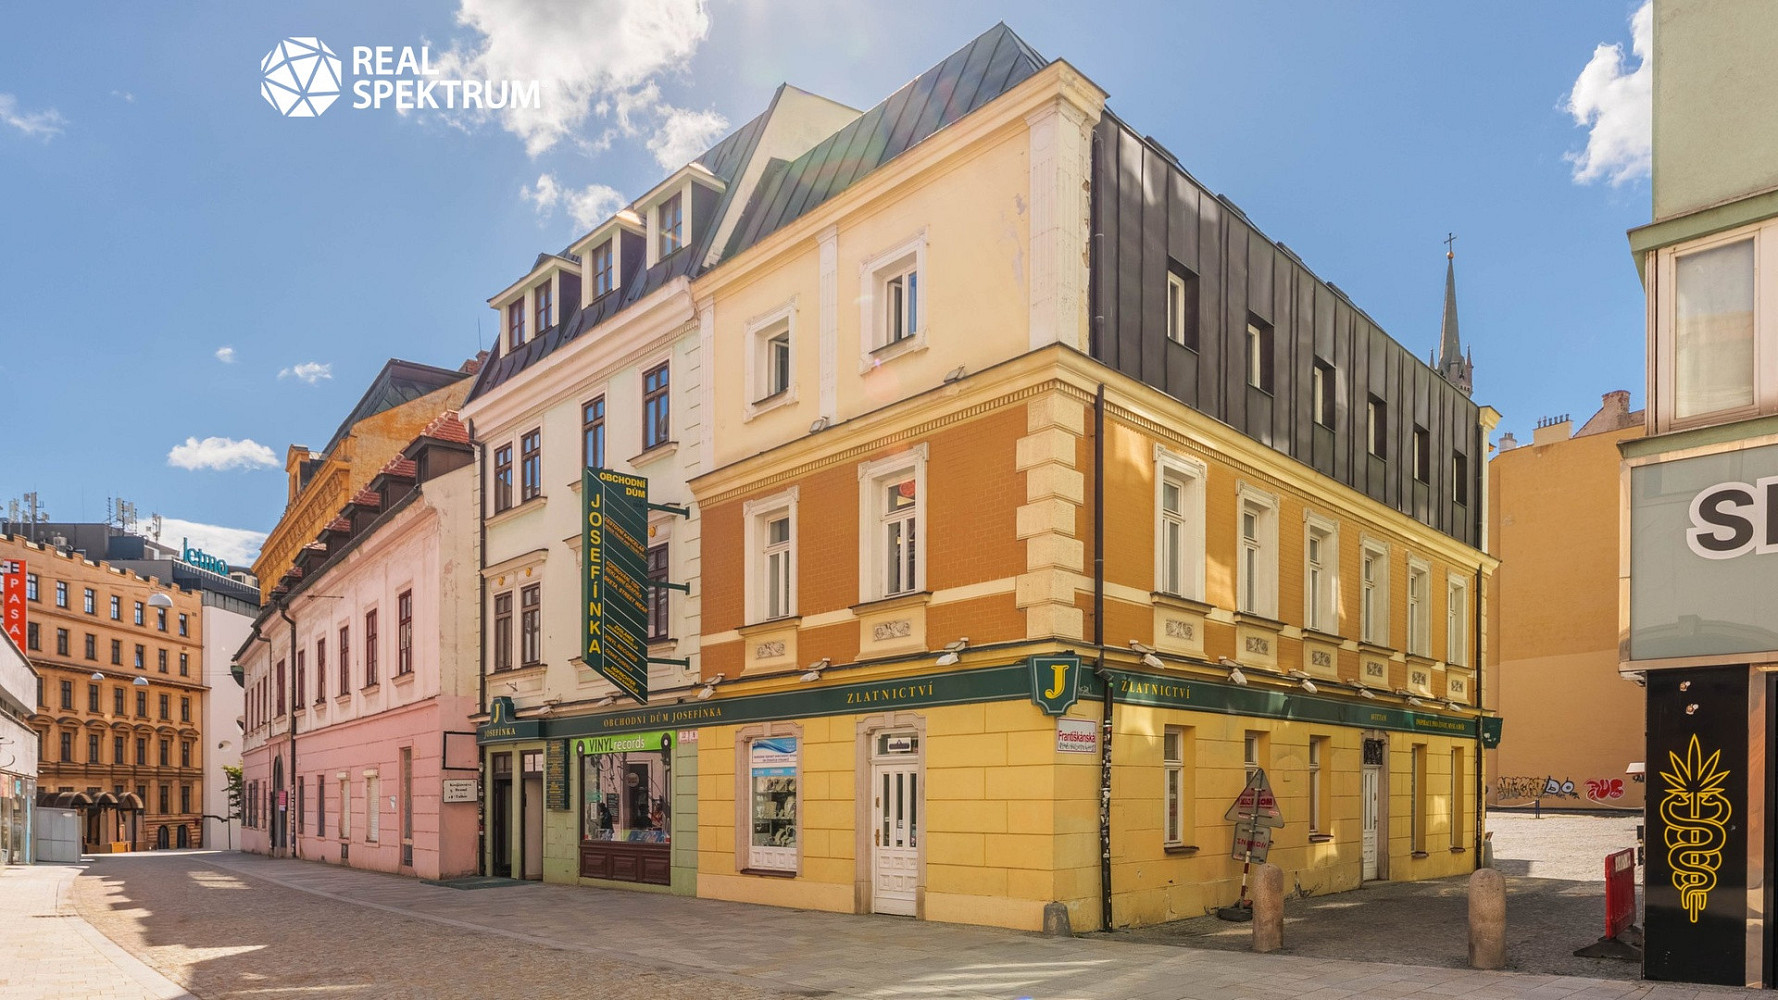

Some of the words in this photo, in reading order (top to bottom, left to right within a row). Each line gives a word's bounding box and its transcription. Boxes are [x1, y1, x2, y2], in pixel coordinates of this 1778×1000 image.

[600, 472, 646, 489] OBCHODNÍ
[626, 486, 646, 499] DŮM
[1695, 482, 1778, 553] S
[589, 493, 603, 655] JOSEFÍNKA
[9, 577, 21, 646] PASÁ
[847, 681, 934, 704] ZLATNICTVÍ
[1045, 664, 1070, 700] J
[1121, 679, 1190, 699] ZLATNICTVÍ
[493, 703, 501, 724] J
[603, 715, 646, 728] OBCHODNÍ
[650, 711, 669, 723] DŮM
[671, 706, 722, 723] JOSEFÍNKA
[484, 727, 516, 740] JOSEFÍNKA
[613, 735, 645, 750] records
[1058, 730, 1096, 743] Františkánská
